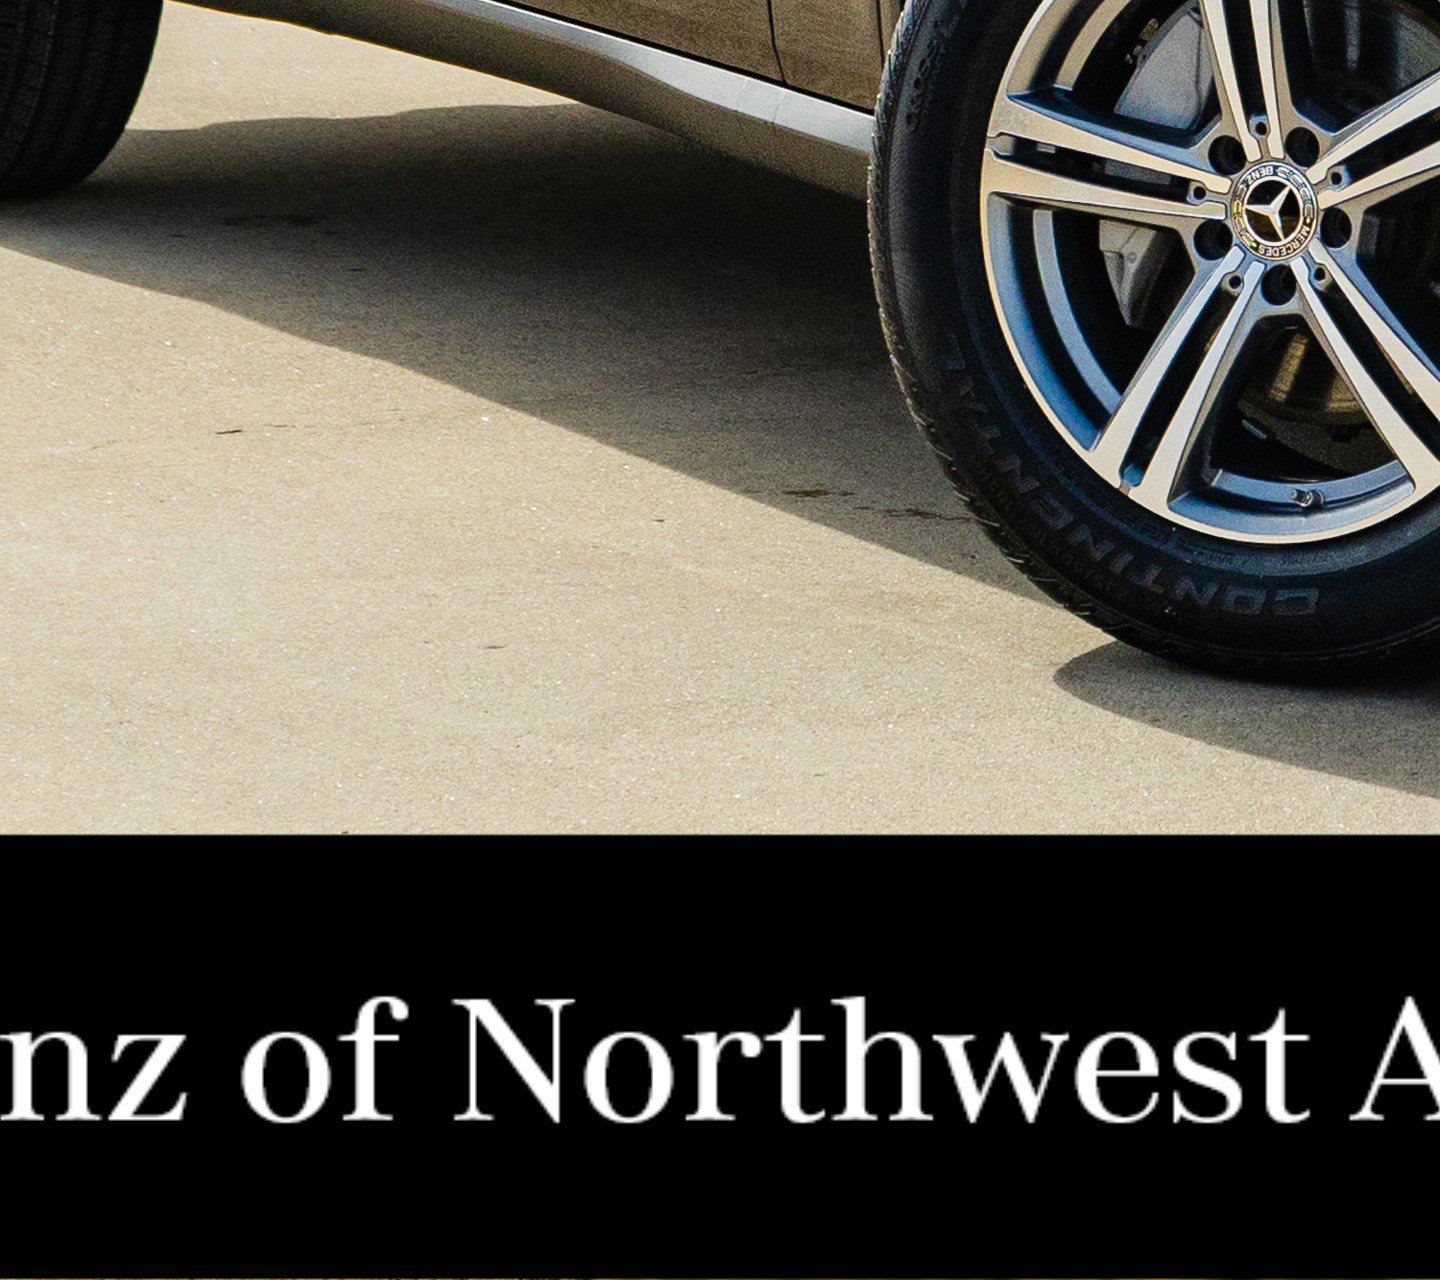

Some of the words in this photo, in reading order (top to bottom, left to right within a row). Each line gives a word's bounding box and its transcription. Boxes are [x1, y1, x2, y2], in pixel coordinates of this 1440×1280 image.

[1246, 165, 1274, 185] BENZ
[1258, 225, 1312, 257] MERCEDES
[946, 333, 1321, 616] CONTINENTAL
